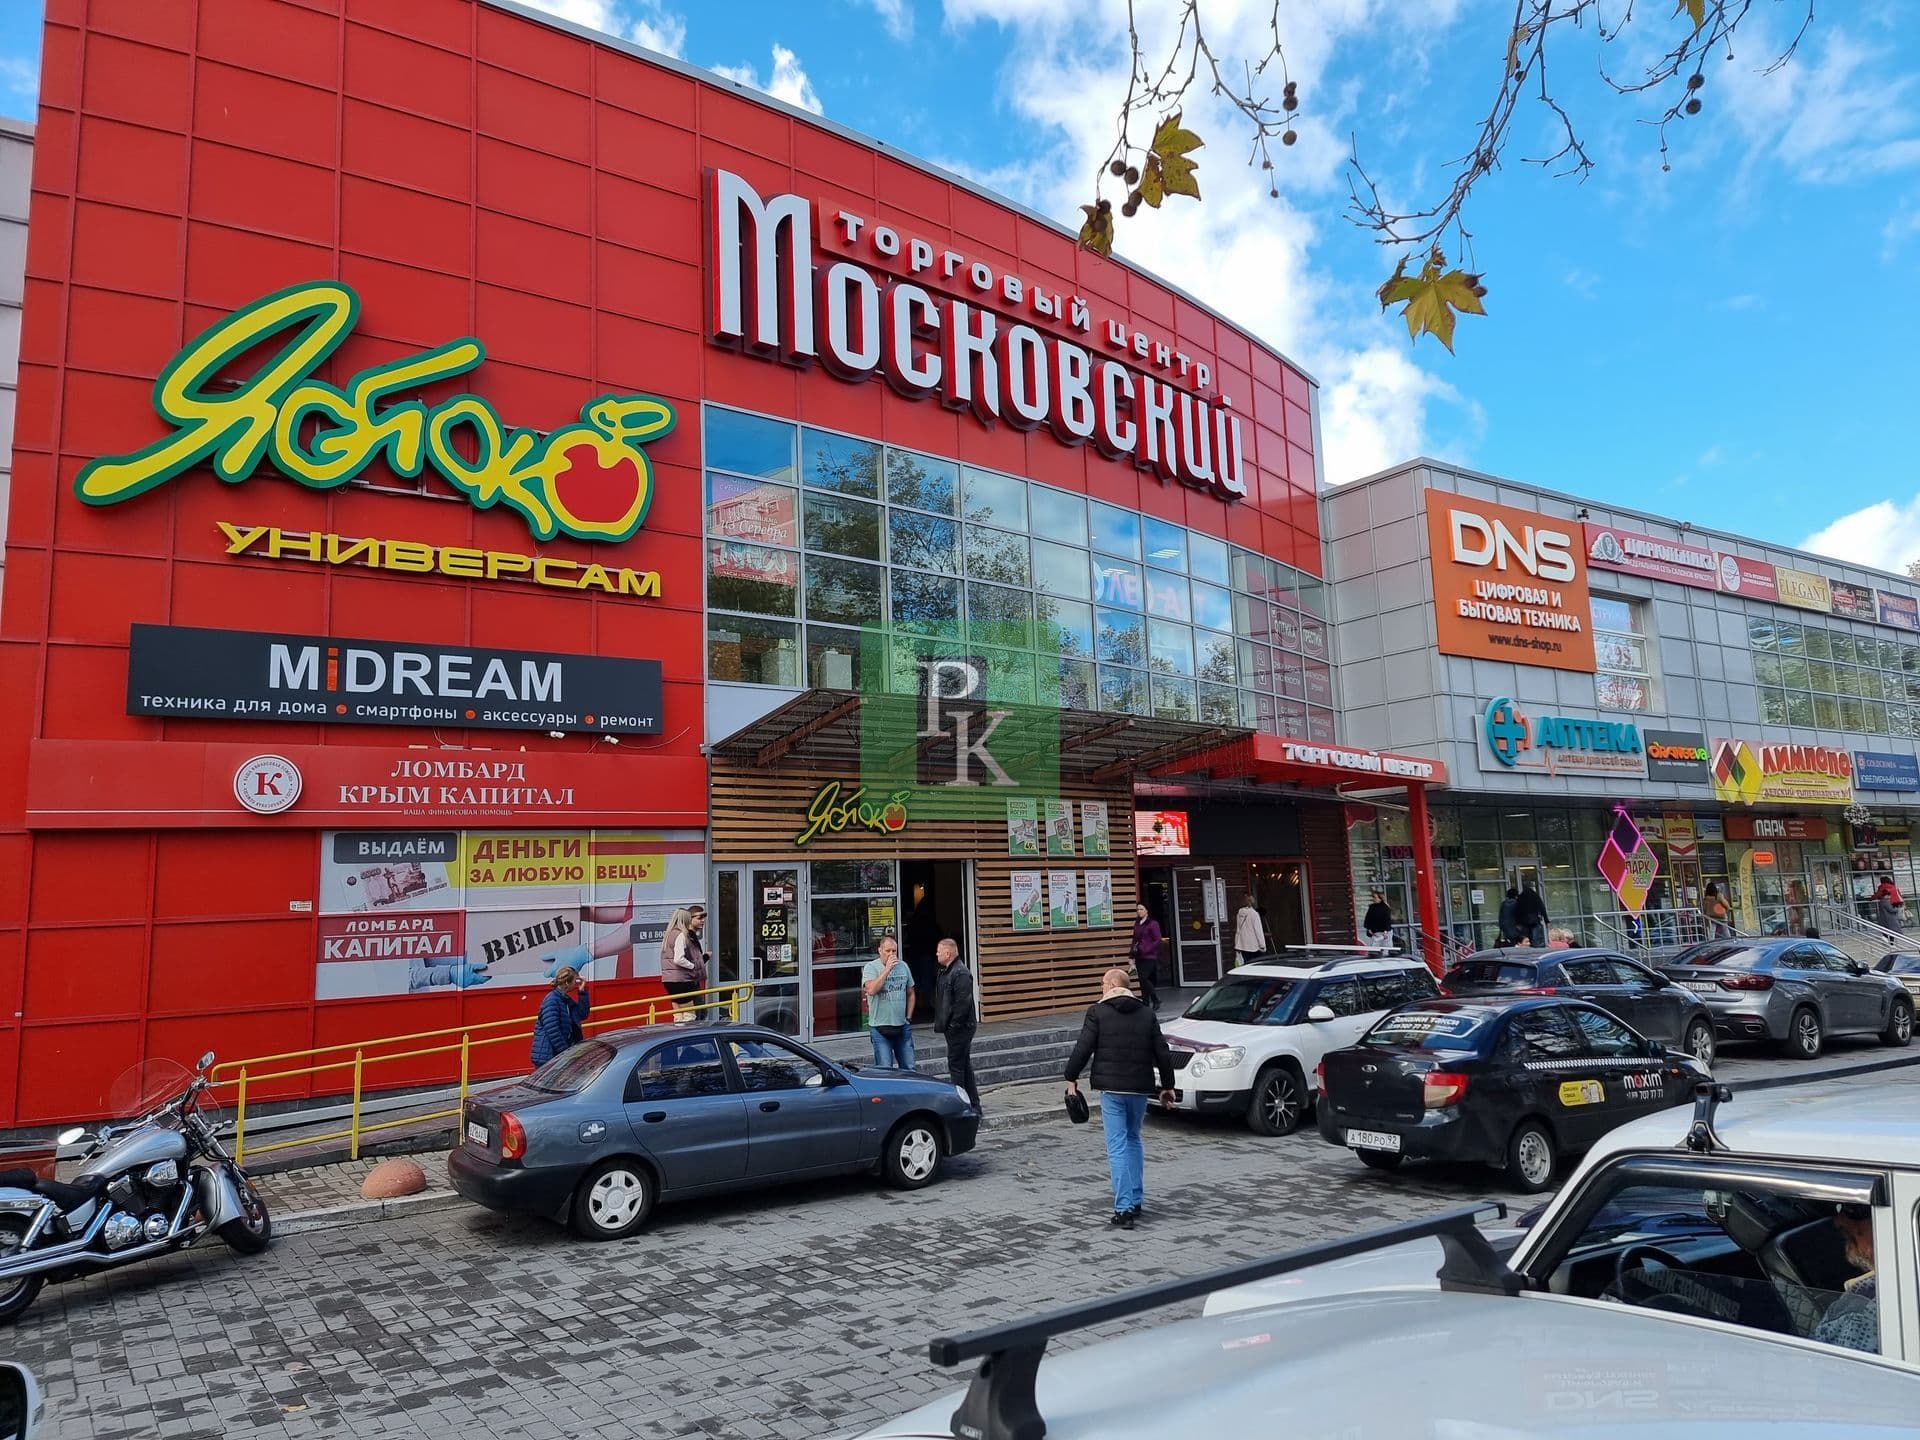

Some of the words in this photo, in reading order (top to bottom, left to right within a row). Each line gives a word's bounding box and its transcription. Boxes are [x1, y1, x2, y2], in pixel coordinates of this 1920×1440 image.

[1448, 509, 1576, 583] DNS
[217, 521, 661, 597] УНИВЕРСАМ
[1473, 579, 1548, 606] ЦИФРОВАЯ
[1551, 591, 1563, 607] И
[1457, 599, 1522, 626] БЫТОВАЯ
[1523, 608, 1582, 632] ТЕХНИКА
[1488, 632, 1563, 653] www.dns-shop.ru
[268, 644, 562, 702] MiDREAM
[140, 695, 226, 710] техника
[233, 698, 271, 712] для
[277, 700, 327, 714] дома
[356, 703, 457, 721] смартфоны
[483, 708, 577, 727] аксессуары
[600, 713, 653, 728] ремонт
[1537, 716, 1643, 754] АПТЕКА
[391, 760, 526, 782] ЛОМБАРД
[1282, 742, 1382, 772] ТОРГОВЫЙ
[1382, 758, 1433, 778] ЦЕНТР
[1760, 746, 1851, 778] ЛИМПОПО
[338, 785, 435, 805] КРЫМ
[439, 786, 574, 805] КАПИТАЛ
[479, 809, 513, 817] ПОМОЩЬ
[1754, 819, 1787, 837] ПАРК
[358, 840, 445, 857] ВЫДАЁМ
[473, 840, 581, 864] ДЕНЬГИ
[470, 869, 495, 883] ЗА
[503, 866, 584, 882] ЛЮБУЮ
[1625, 860, 1651, 873] ПАРК
[345, 918, 434, 933] ЛОМБАРД
[323, 935, 452, 959] КАПИТАЛ
[481, 914, 576, 964] ВЕЩЬ
